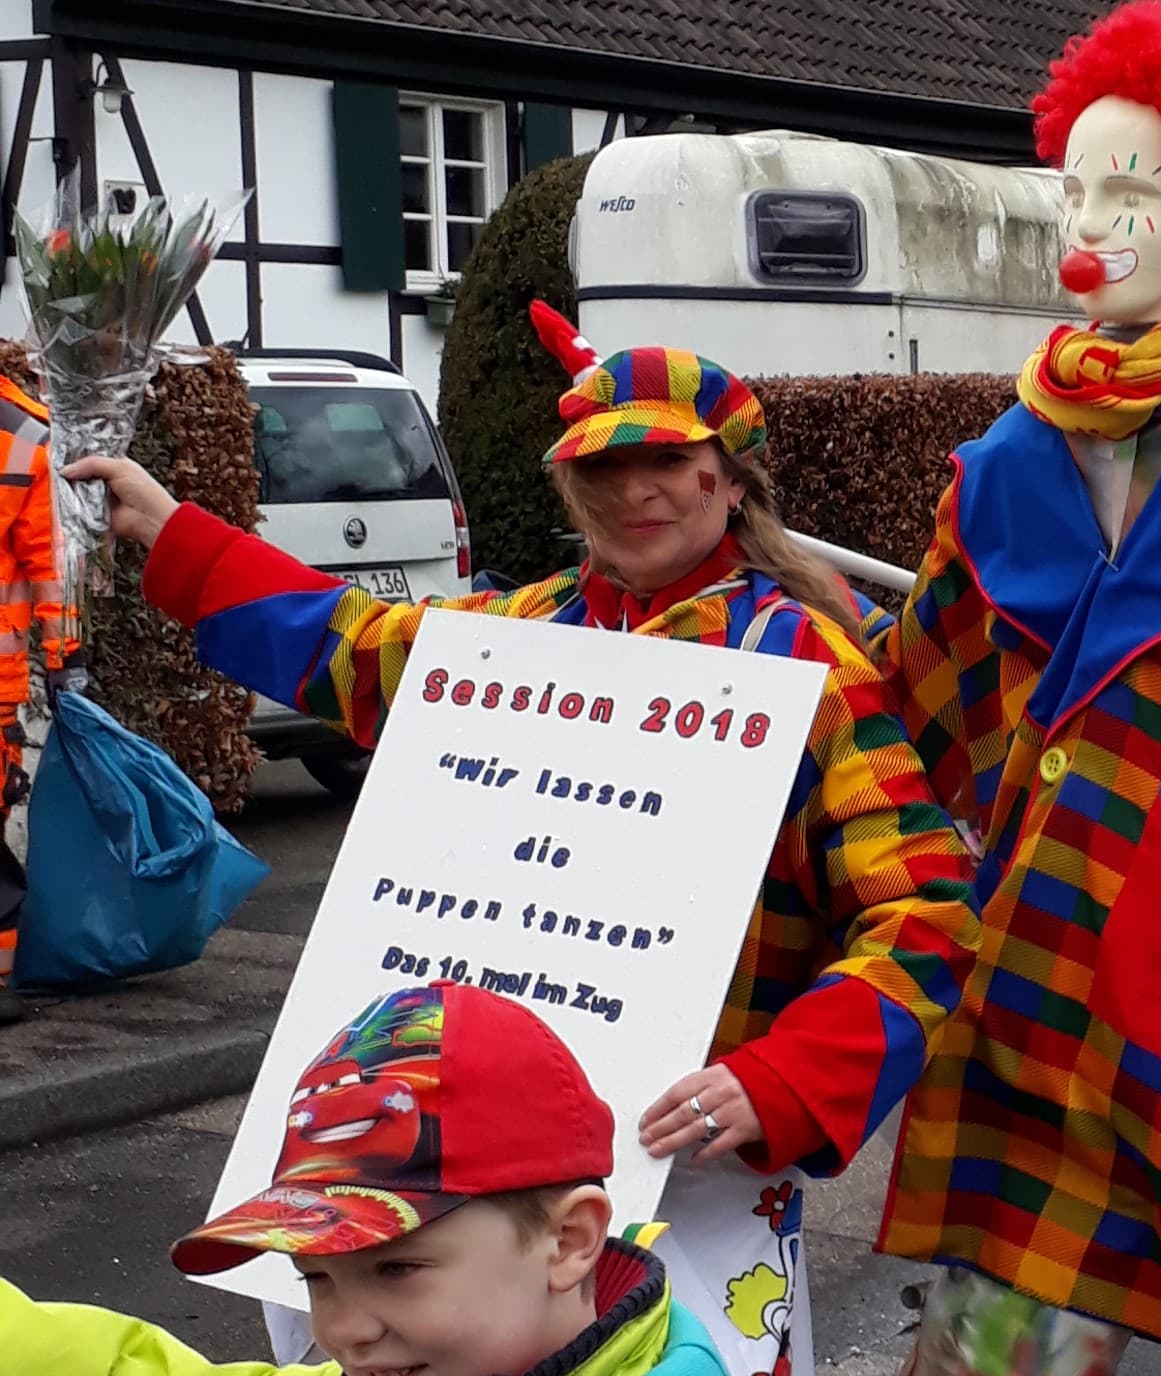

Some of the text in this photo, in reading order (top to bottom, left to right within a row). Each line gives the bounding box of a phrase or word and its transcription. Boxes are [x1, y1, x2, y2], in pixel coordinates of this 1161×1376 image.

[370, 572, 405, 595] 136
[422, 667, 771, 749] Session 2018
[535, 768, 663, 817] lassen
[513, 835, 571, 869] die
[372, 877, 503, 922] Puppen
[381, 945, 430, 978] Das
[438, 955, 474, 985] 10.
[531, 972, 568, 1006] im
[569, 981, 624, 1023] Zug
